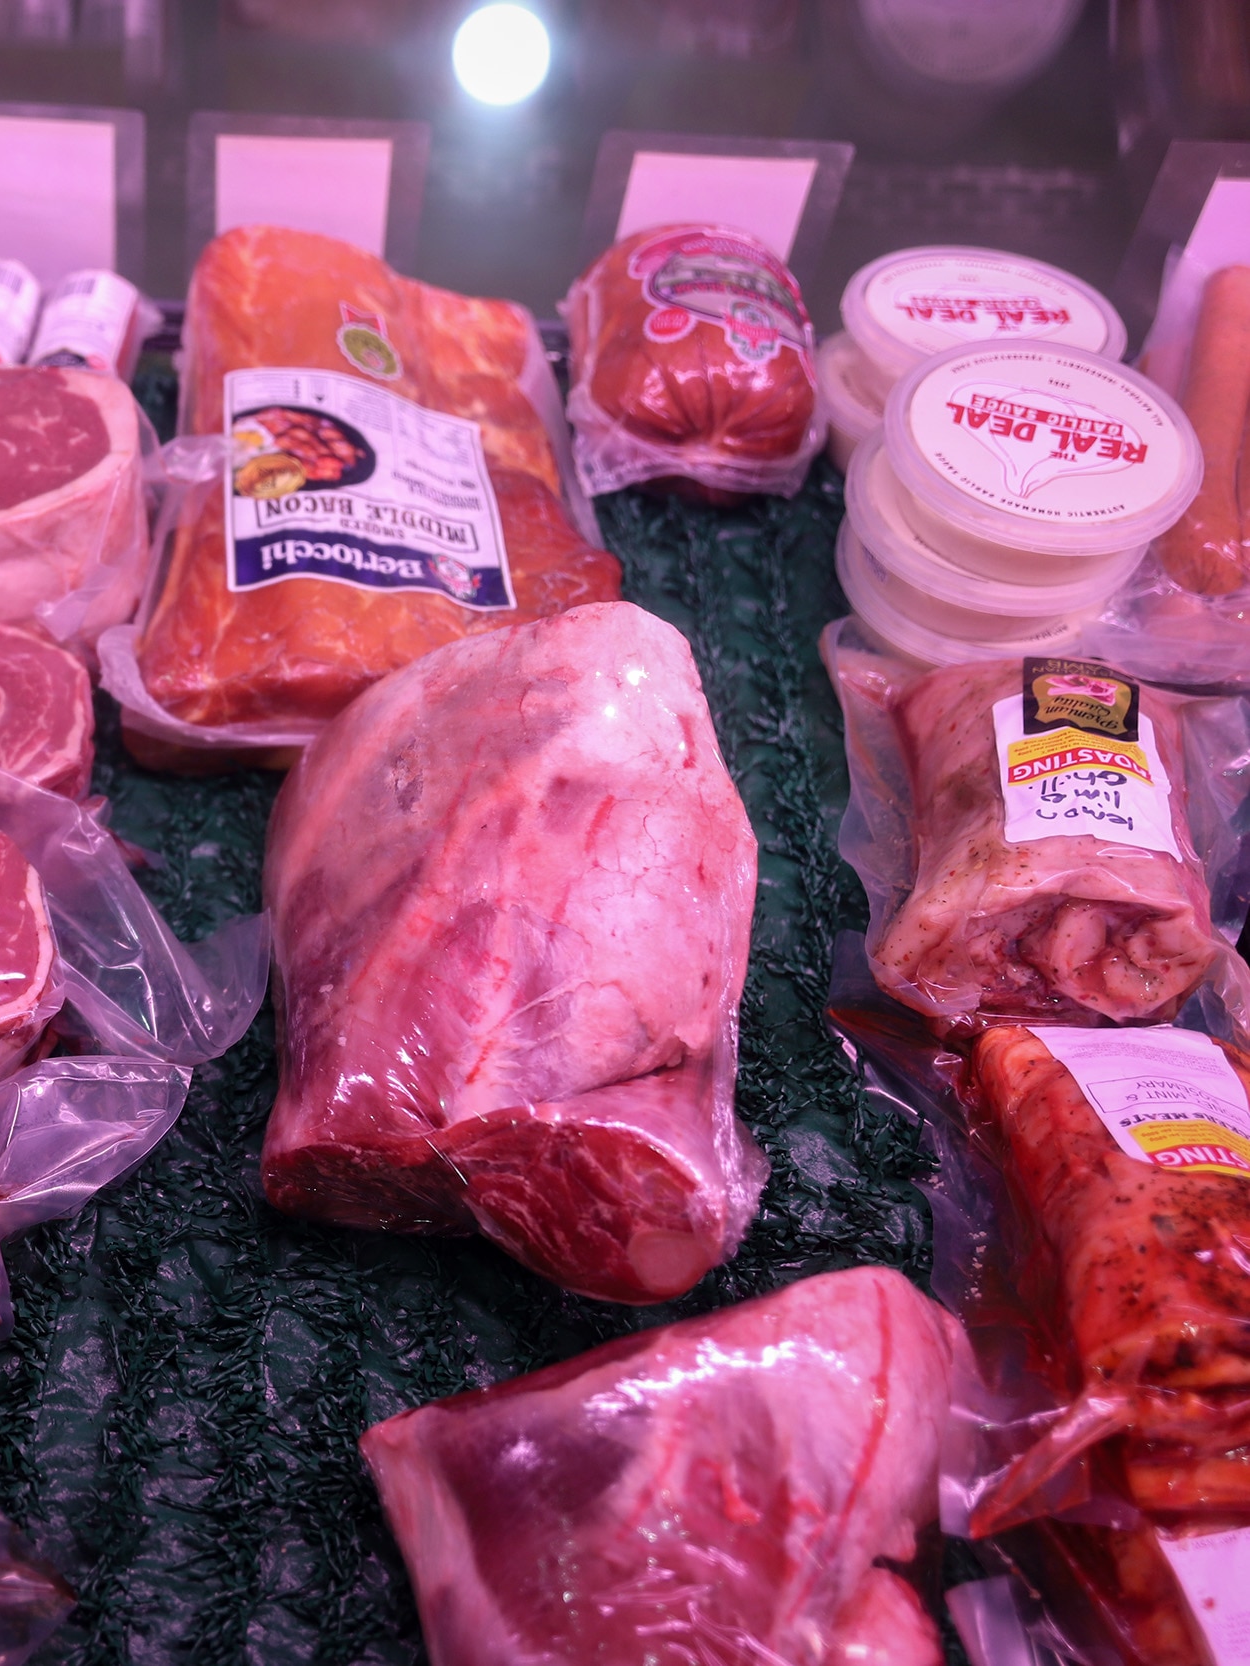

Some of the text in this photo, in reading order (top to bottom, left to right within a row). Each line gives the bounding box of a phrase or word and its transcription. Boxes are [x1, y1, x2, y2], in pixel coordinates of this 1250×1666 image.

[895, 304, 1070, 326] REAL DEAL
[973, 395, 1122, 436] GARLIC SAUCE
[946, 403, 1148, 464] REAL DEAL
[1049, 451, 1078, 463] THE
[264, 496, 468, 546] MIDDLE BACON
[340, 518, 406, 541] SMOKED
[260, 539, 425, 580] Bertocchi
[1052, 696, 1111, 717] Quality
[1044, 706, 1119, 730] Premium
[1040, 789, 1121, 809] lime
[1125, 1094, 1138, 1102] &
[1146, 1089, 1186, 1100] MINT
[1119, 1112, 1191, 1128] MEATS
